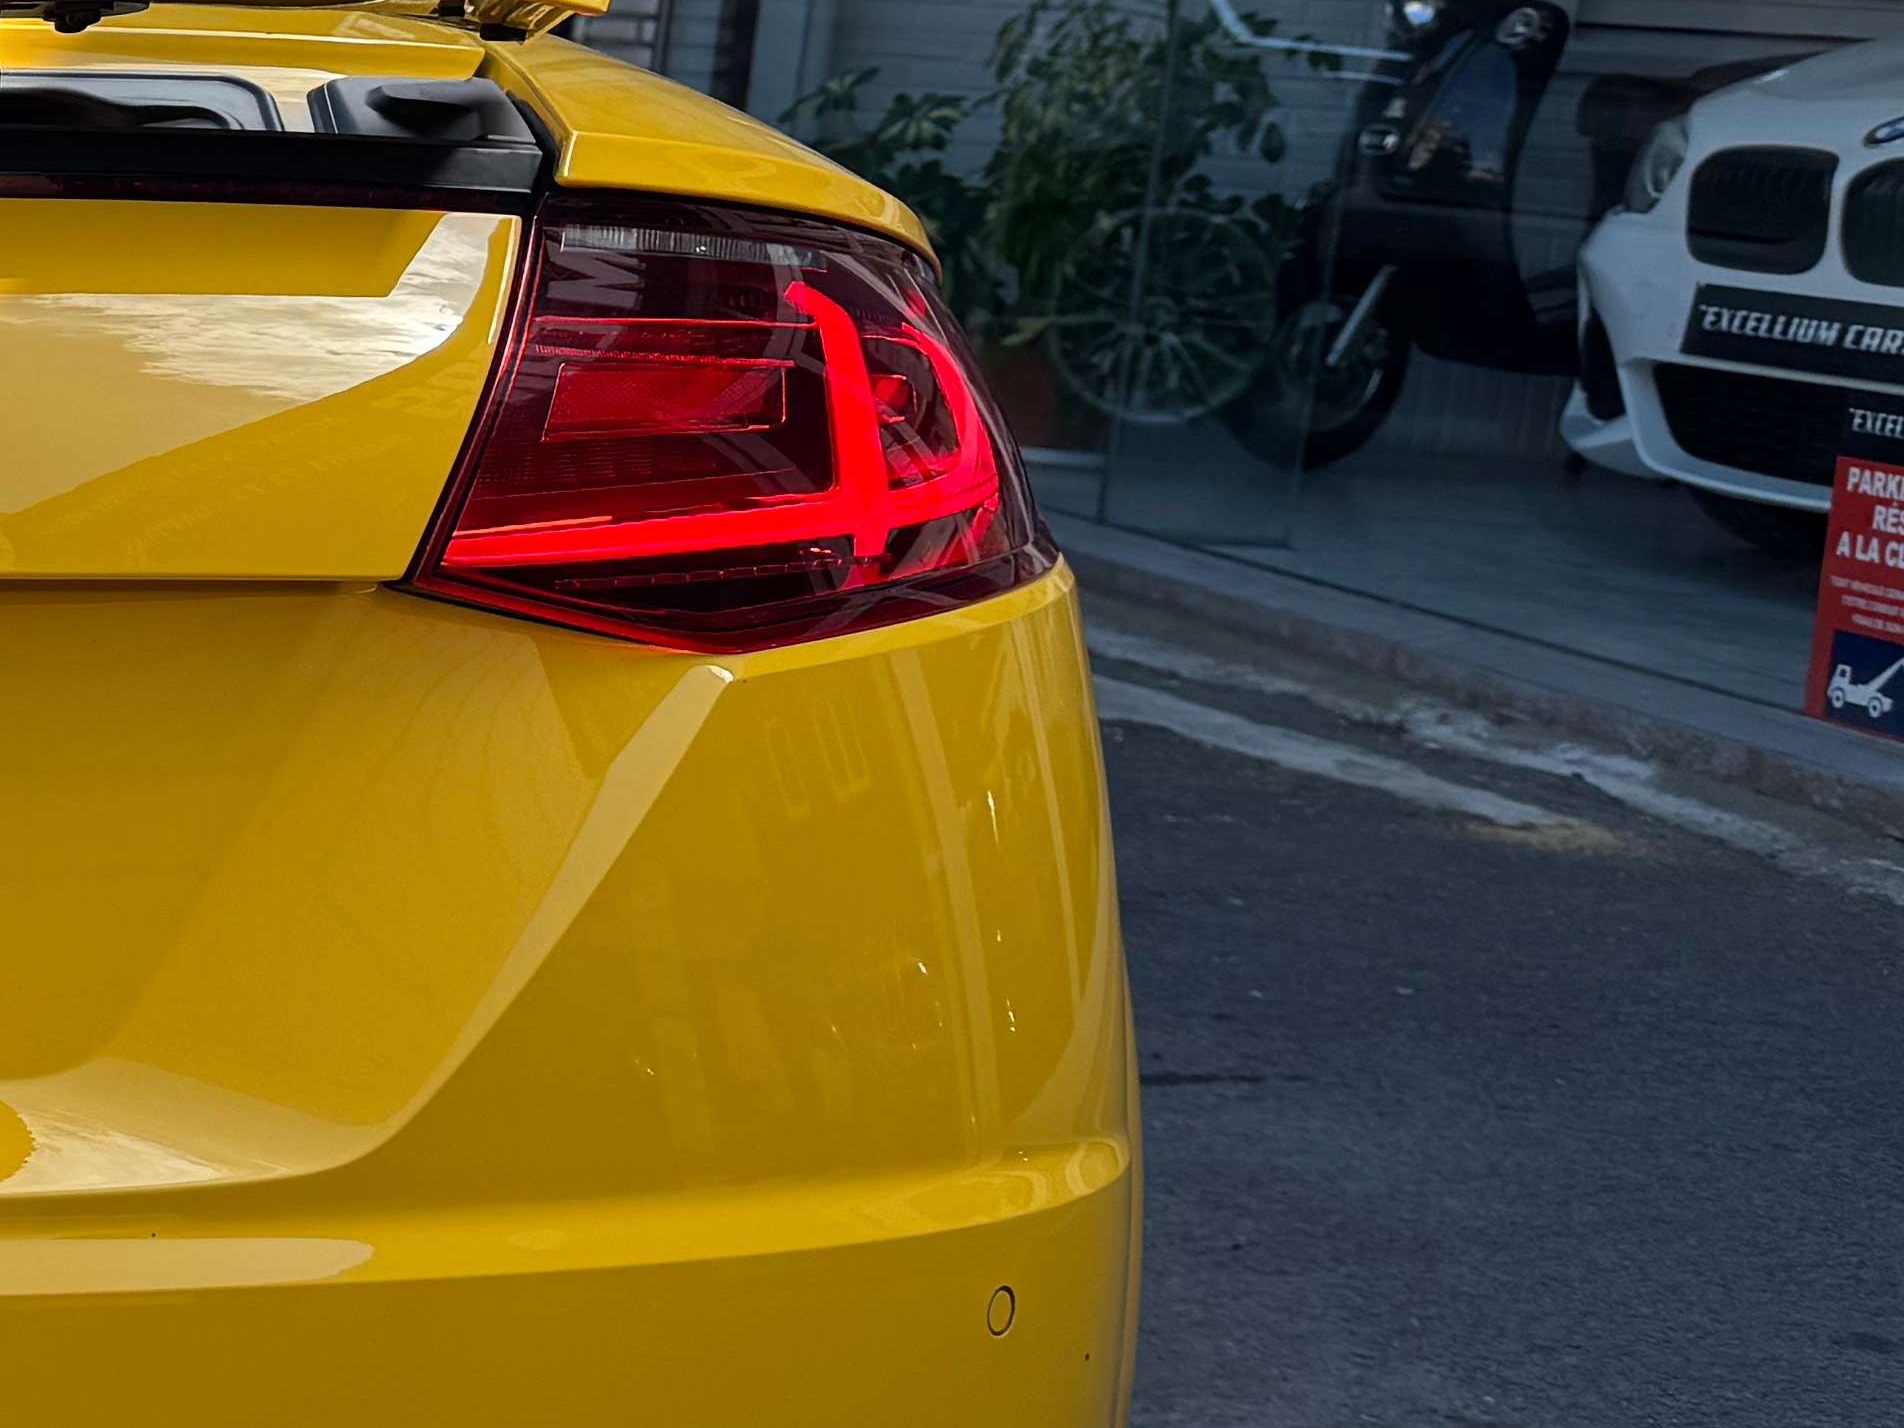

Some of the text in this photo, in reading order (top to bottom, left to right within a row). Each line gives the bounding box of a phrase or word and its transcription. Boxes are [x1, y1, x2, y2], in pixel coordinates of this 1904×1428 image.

[1699, 305, 1904, 354] EXCELLIUM CAR
[1836, 531, 1850, 557] A
[1855, 534, 1880, 563] LA
